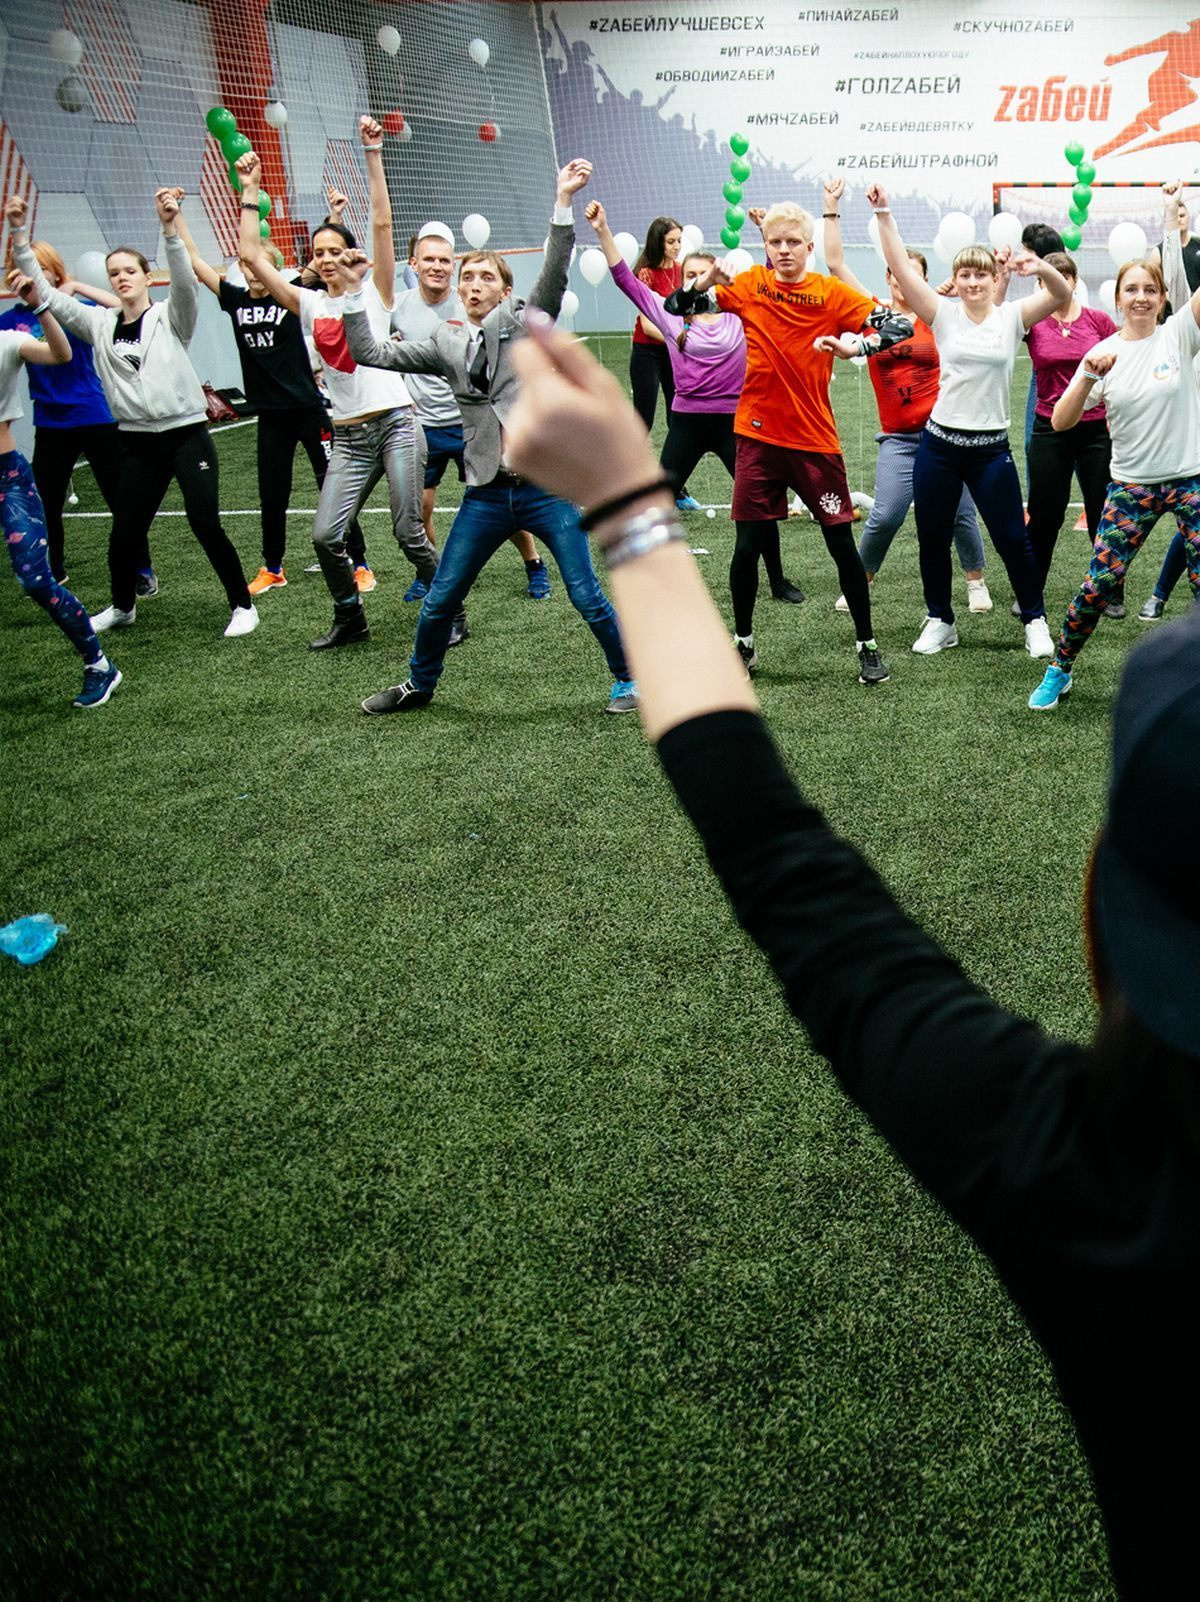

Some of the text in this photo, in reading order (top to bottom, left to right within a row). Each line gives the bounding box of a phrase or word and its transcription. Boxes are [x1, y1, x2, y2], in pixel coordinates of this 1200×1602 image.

[589, 15, 765, 33] #ZАБЕЙЛУЧШЕВСЕХ
[835, 74, 961, 95] #ГОЛZАБЕЙ
[787, 293, 825, 305] STREET
[244, 330, 275, 348] DAY
